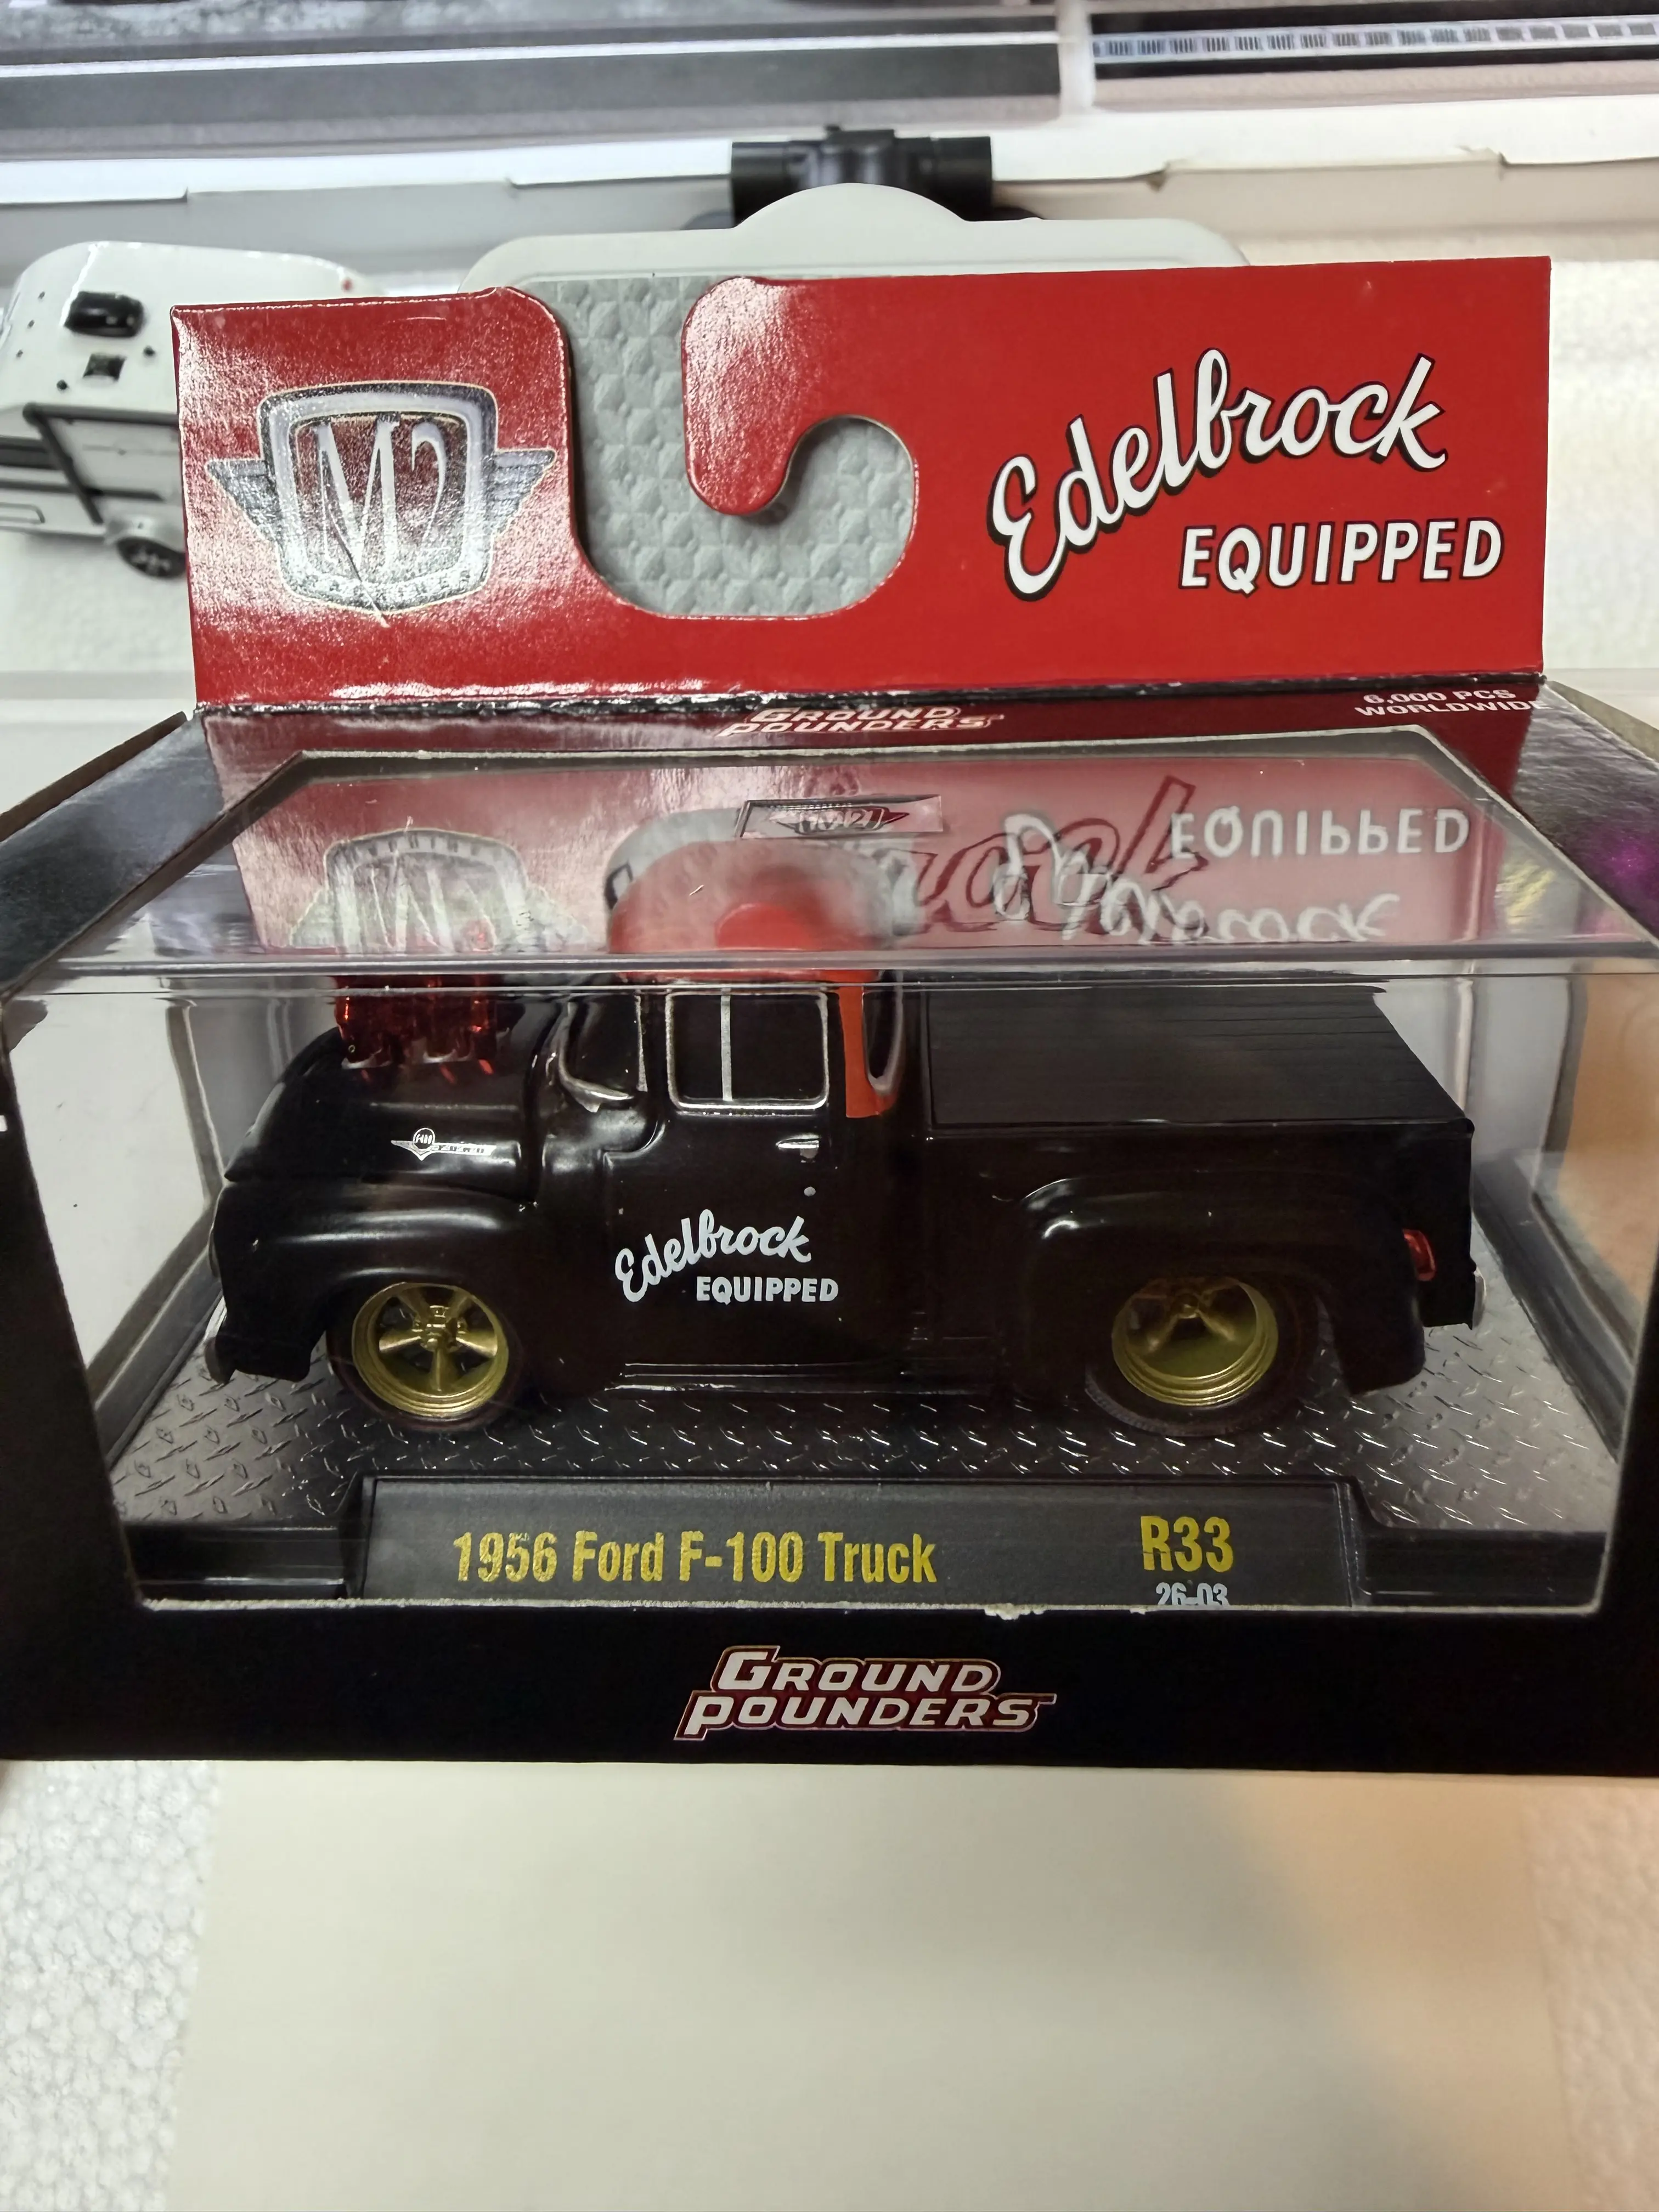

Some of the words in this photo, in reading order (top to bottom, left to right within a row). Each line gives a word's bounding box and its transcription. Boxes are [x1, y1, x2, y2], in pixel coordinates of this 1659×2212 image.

[988, 348, 1447, 601] Edelbrock
[1179, 518, 1504, 597] EQUIPPED
[749, 707, 960, 723] GROUND
[1353, 700, 1553, 716] WORLDWIDE
[1363, 691, 1447, 704] 6,000
[1453, 689, 1516, 701] PCS
[714, 715, 992, 737] POUNDERS
[614, 1209, 812, 1303] Edelbrock
[696, 1276, 839, 1306] EQUIPPED
[453, 1531, 557, 1583] 1956
[572, 1530, 665, 1583] Ford
[678, 1530, 806, 1583] F-100
[817, 1531, 938, 1583] Truck
[1140, 1515, 1234, 1573] R33
[713, 1647, 998, 1693] GROUND
[676, 1695, 1042, 1738] POUNDERS
